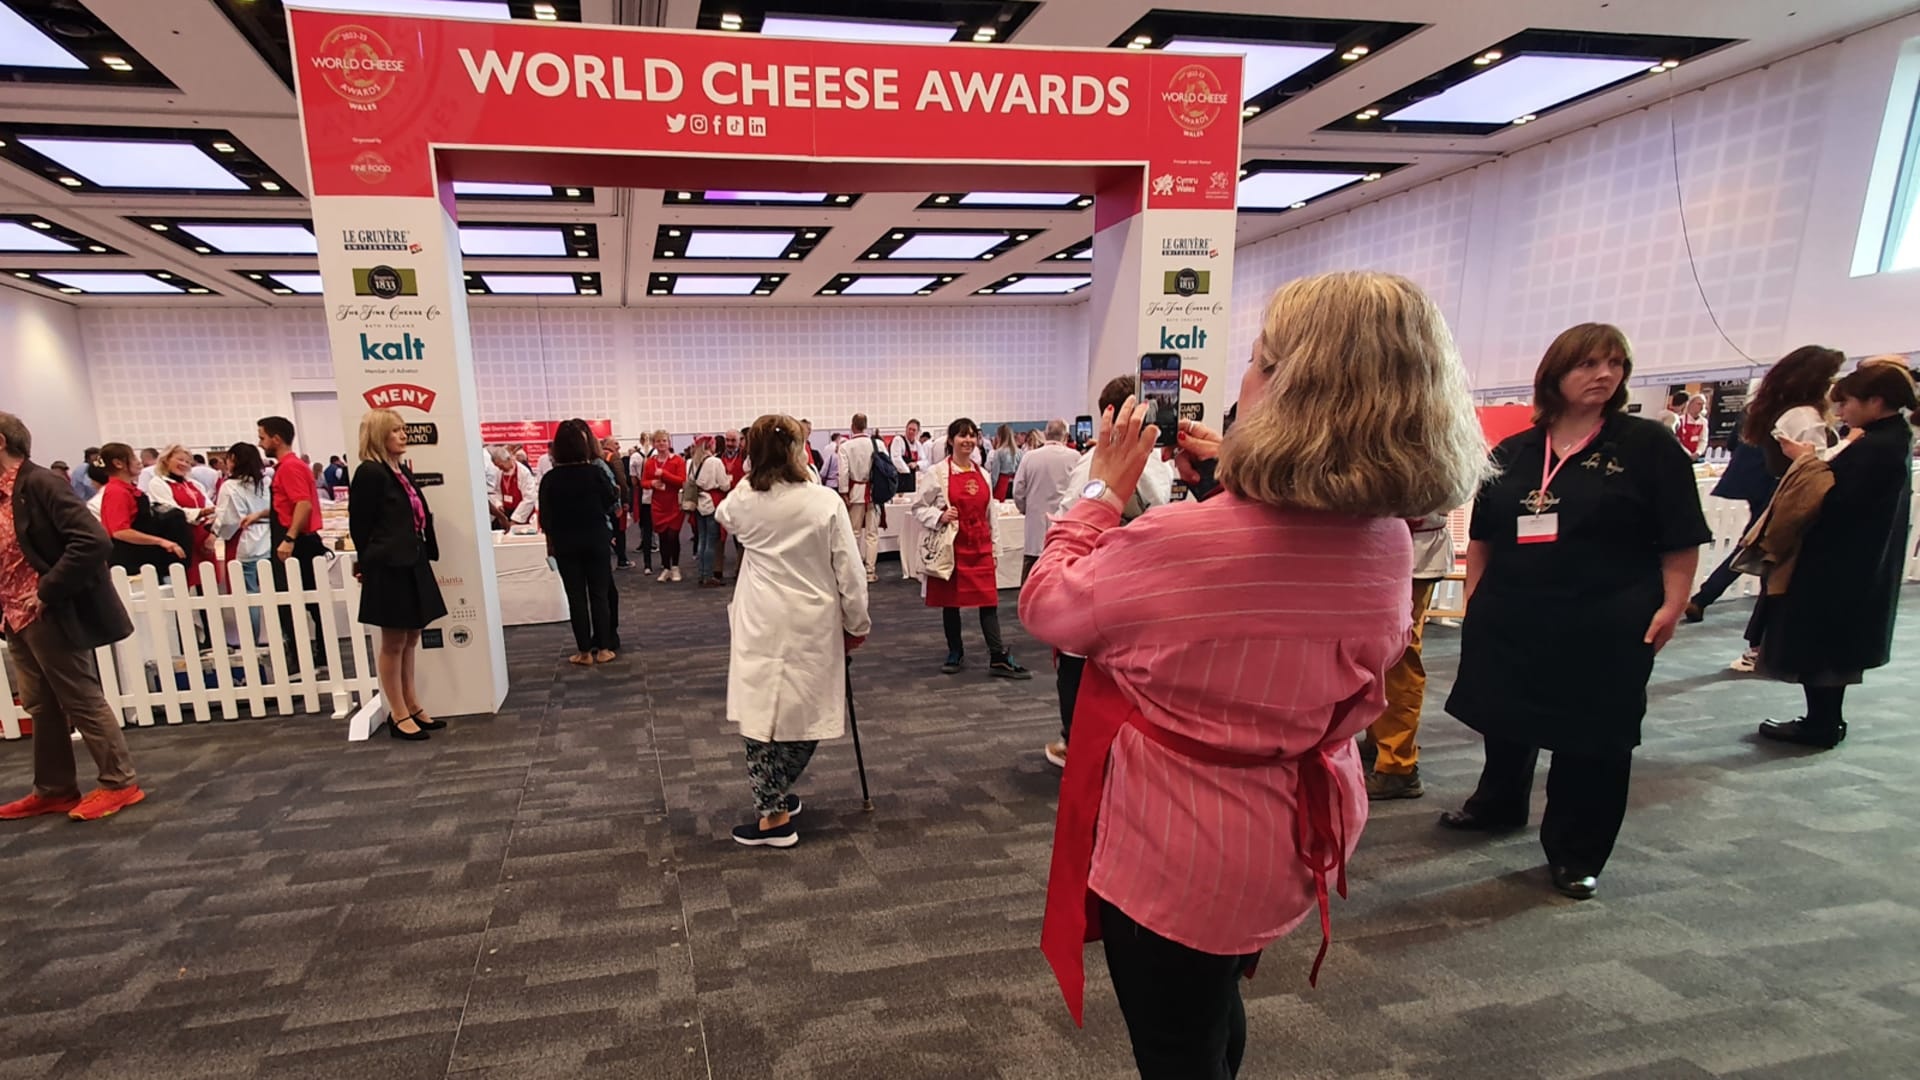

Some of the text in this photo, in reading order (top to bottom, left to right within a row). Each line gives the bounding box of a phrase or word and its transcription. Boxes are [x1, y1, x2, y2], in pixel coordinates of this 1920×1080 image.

[311, 57, 405, 72] WORLD CHEESE
[458, 48, 1130, 116] WORLD CHEESE AWARDS
[340, 83, 381, 97] AWARDS
[1161, 92, 1228, 105] WORLD CHEESE
[349, 102, 377, 112] WALES
[349, 164, 392, 173] FINE FOOD
[1175, 175, 1198, 187] Cymru
[342, 228, 408, 244] LE GRUYÈRE
[1162, 238, 1172, 249] LE
[1160, 325, 1207, 349] kalt
[360, 332, 426, 361] kalt
[1183, 373, 1203, 387] NY
[371, 388, 429, 406] MENY
[404, 424, 433, 434] GIANO
